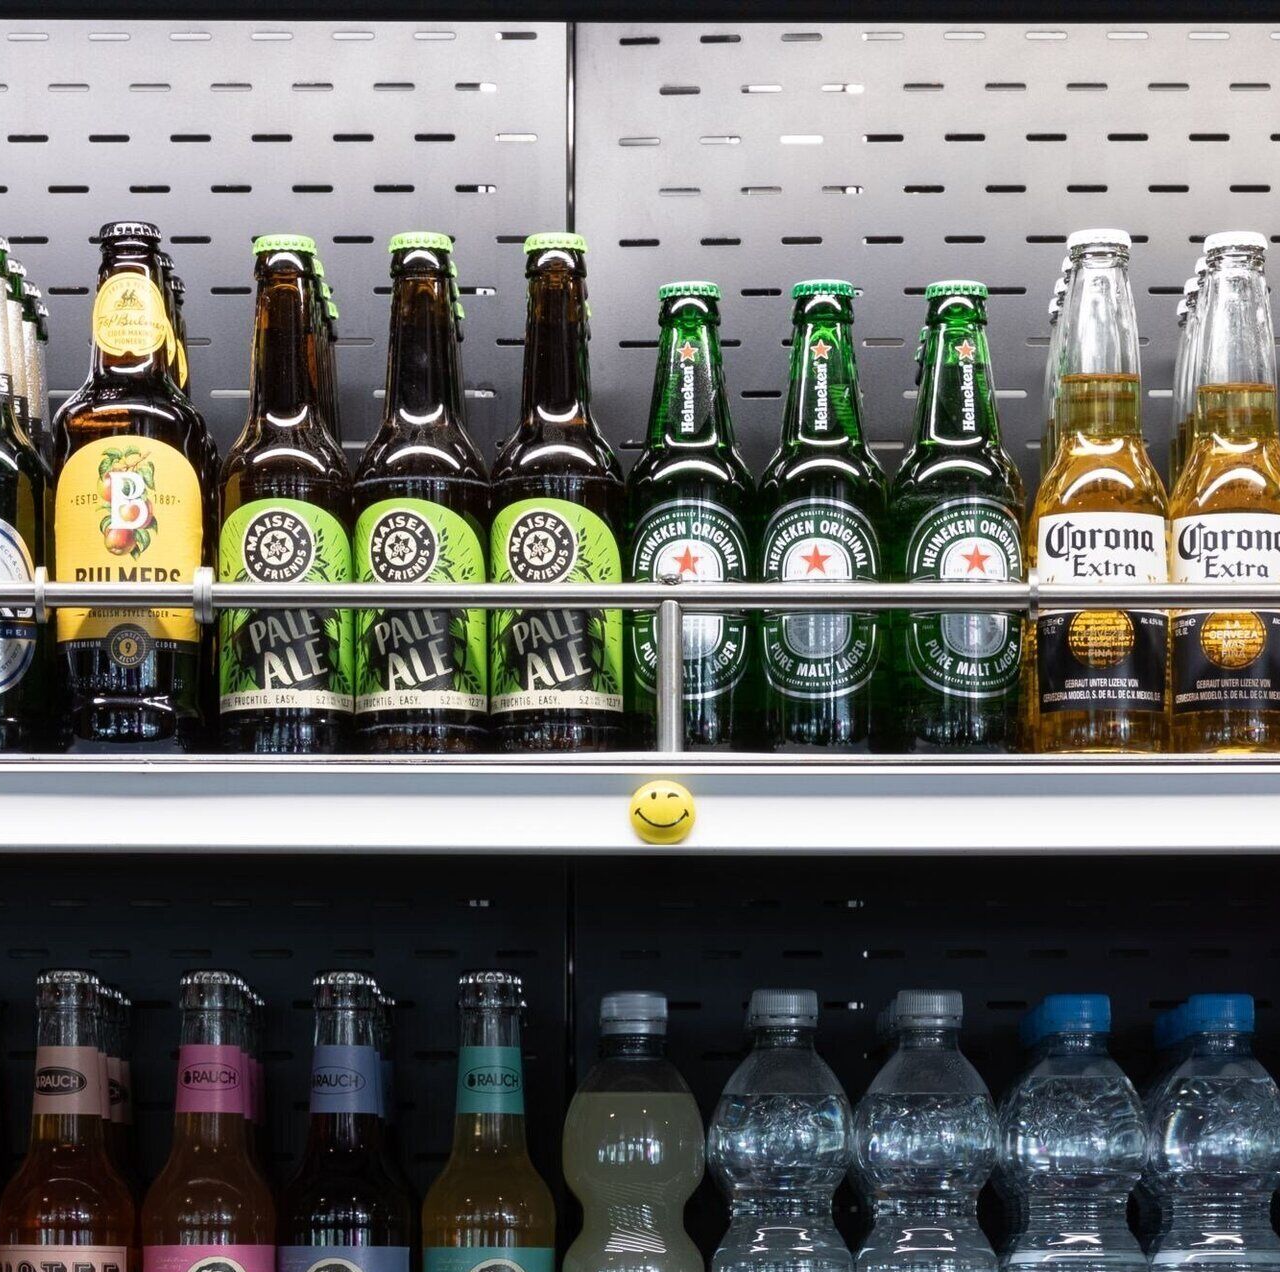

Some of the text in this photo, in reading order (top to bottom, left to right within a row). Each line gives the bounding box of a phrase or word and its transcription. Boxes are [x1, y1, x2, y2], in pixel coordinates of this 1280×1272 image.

[681, 366, 694, 433] Heineken
[815, 365, 828, 431] Heineken
[963, 366, 976, 432] Heineken
[154, 494, 176, 505] 1887
[247, 515, 303, 551] MAISEL
[372, 516, 427, 552] MAISEL
[510, 516, 565, 553] MAISEL
[639, 521, 738, 572] HEINEKEN ORIGINAL
[769, 520, 869, 571] HEINEKEN ORIGINAL
[922, 521, 1018, 570] HEINEKEN ORIGINAL
[1045, 521, 1154, 562] Corona
[263, 549, 307, 580] FRIENDS
[389, 549, 430, 580] FRIENDS
[527, 549, 569, 581] FRIENDS
[1073, 555, 1136, 577] Extra
[1205, 555, 1269, 579] Extra
[70, 641, 178, 649] PREMIUM CIDER
[250, 608, 320, 653] PALE
[375, 609, 443, 652] PALE
[513, 609, 585, 653] PALE
[263, 638, 328, 690] ALE
[388, 637, 453, 690] ALE
[527, 638, 592, 691] ALE
[771, 640, 866, 677] PURE MALT LAGER
[192, 1071, 237, 1085] RAUCH
[477, 1075, 520, 1088] RAUCH
